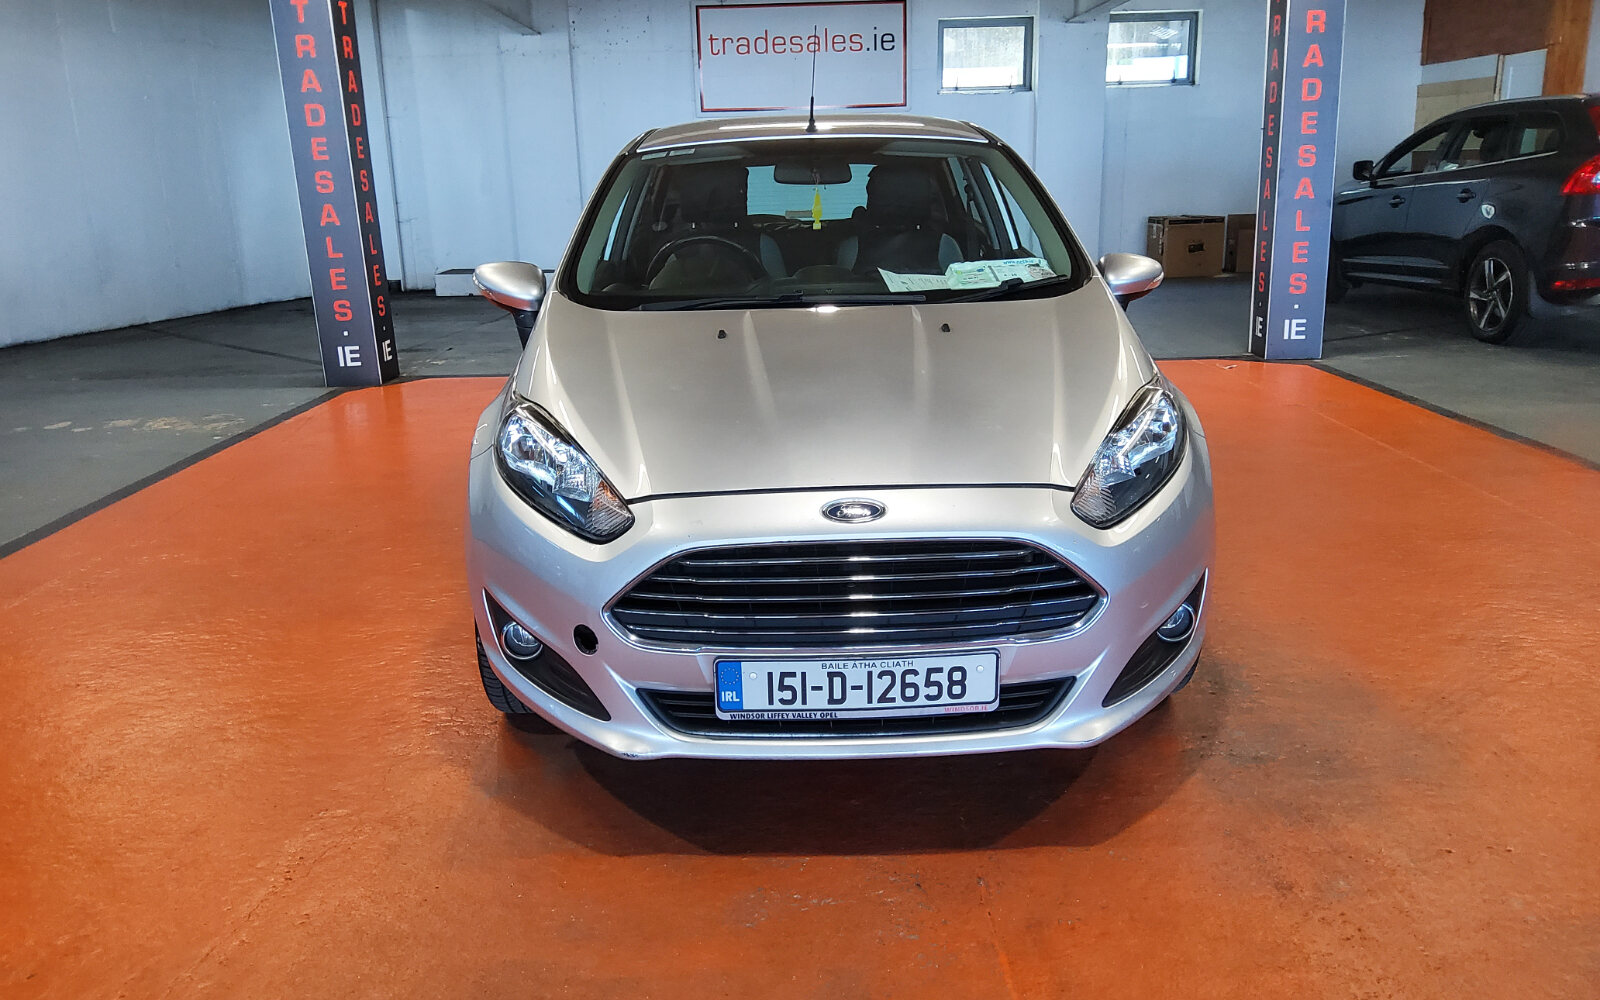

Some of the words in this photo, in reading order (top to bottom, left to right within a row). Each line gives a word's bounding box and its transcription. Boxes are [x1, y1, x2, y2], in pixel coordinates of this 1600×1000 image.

[708, 26, 896, 56] tradesales.ie
[821, 662, 849, 670] BAILE
[880, 660, 914, 669] CLIATH
[766, 666, 968, 706] 151-D-12658
[721, 691, 740, 702] IRL
[766, 712, 790, 720] LIFFEY
